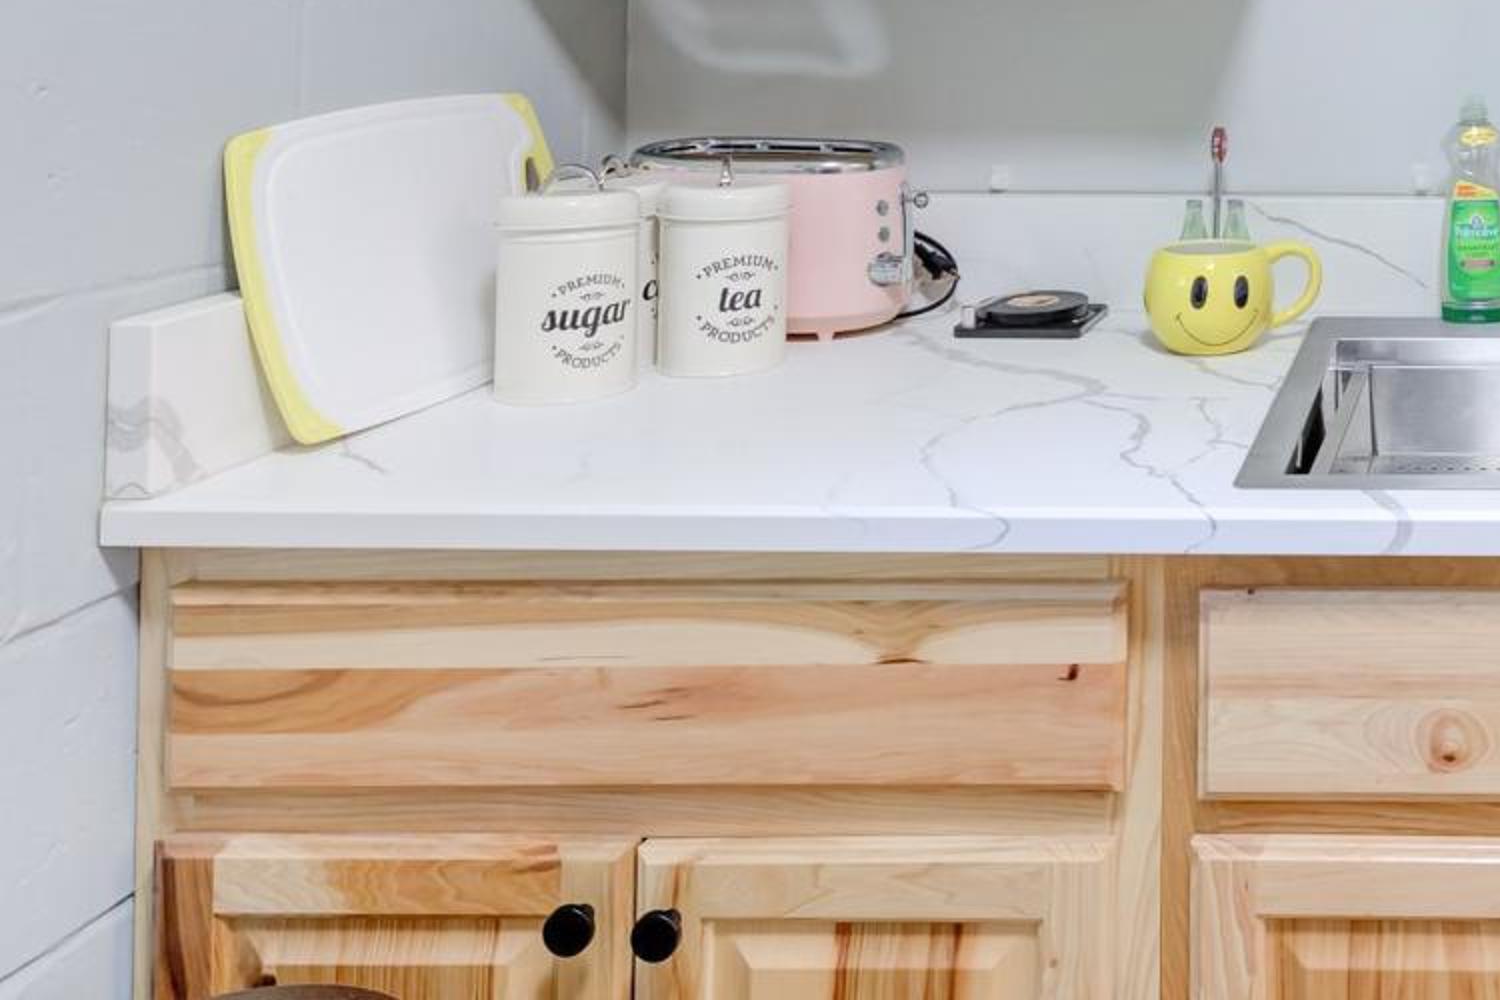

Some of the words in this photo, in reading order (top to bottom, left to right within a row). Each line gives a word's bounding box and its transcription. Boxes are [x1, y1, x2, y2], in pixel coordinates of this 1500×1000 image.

[702, 255, 774, 277] PREMIUM
[557, 273, 622, 295] PREMIUM
[719, 287, 763, 313] tea
[541, 299, 631, 338] sugar
